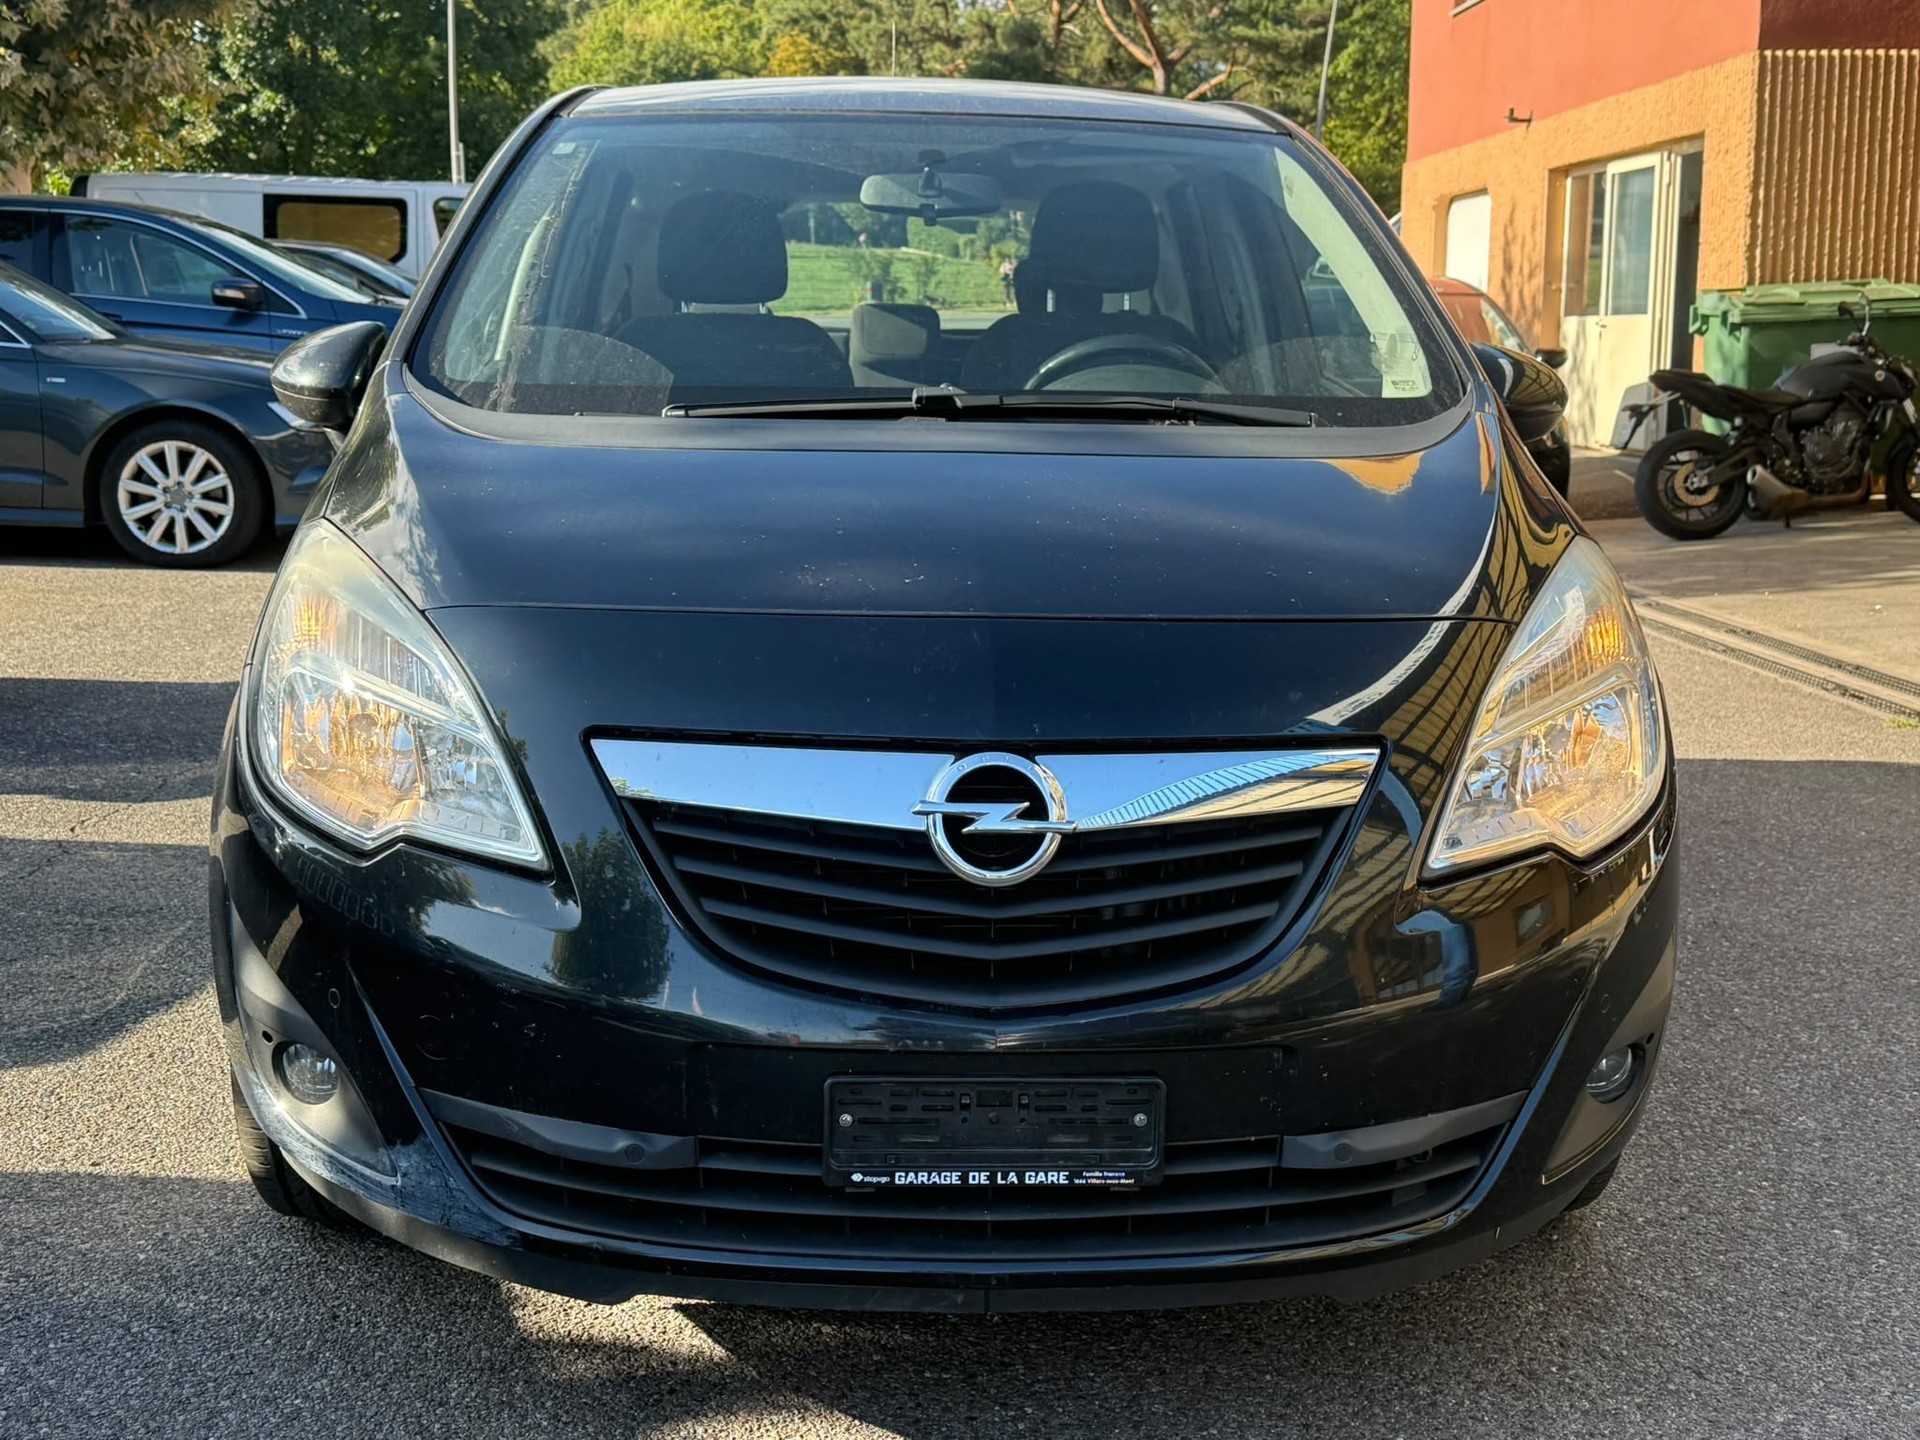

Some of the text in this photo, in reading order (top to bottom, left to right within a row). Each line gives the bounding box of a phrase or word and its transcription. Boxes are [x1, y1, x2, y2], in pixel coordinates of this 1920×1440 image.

[894, 1171, 1070, 1185] GARAGE DE LA GARE
